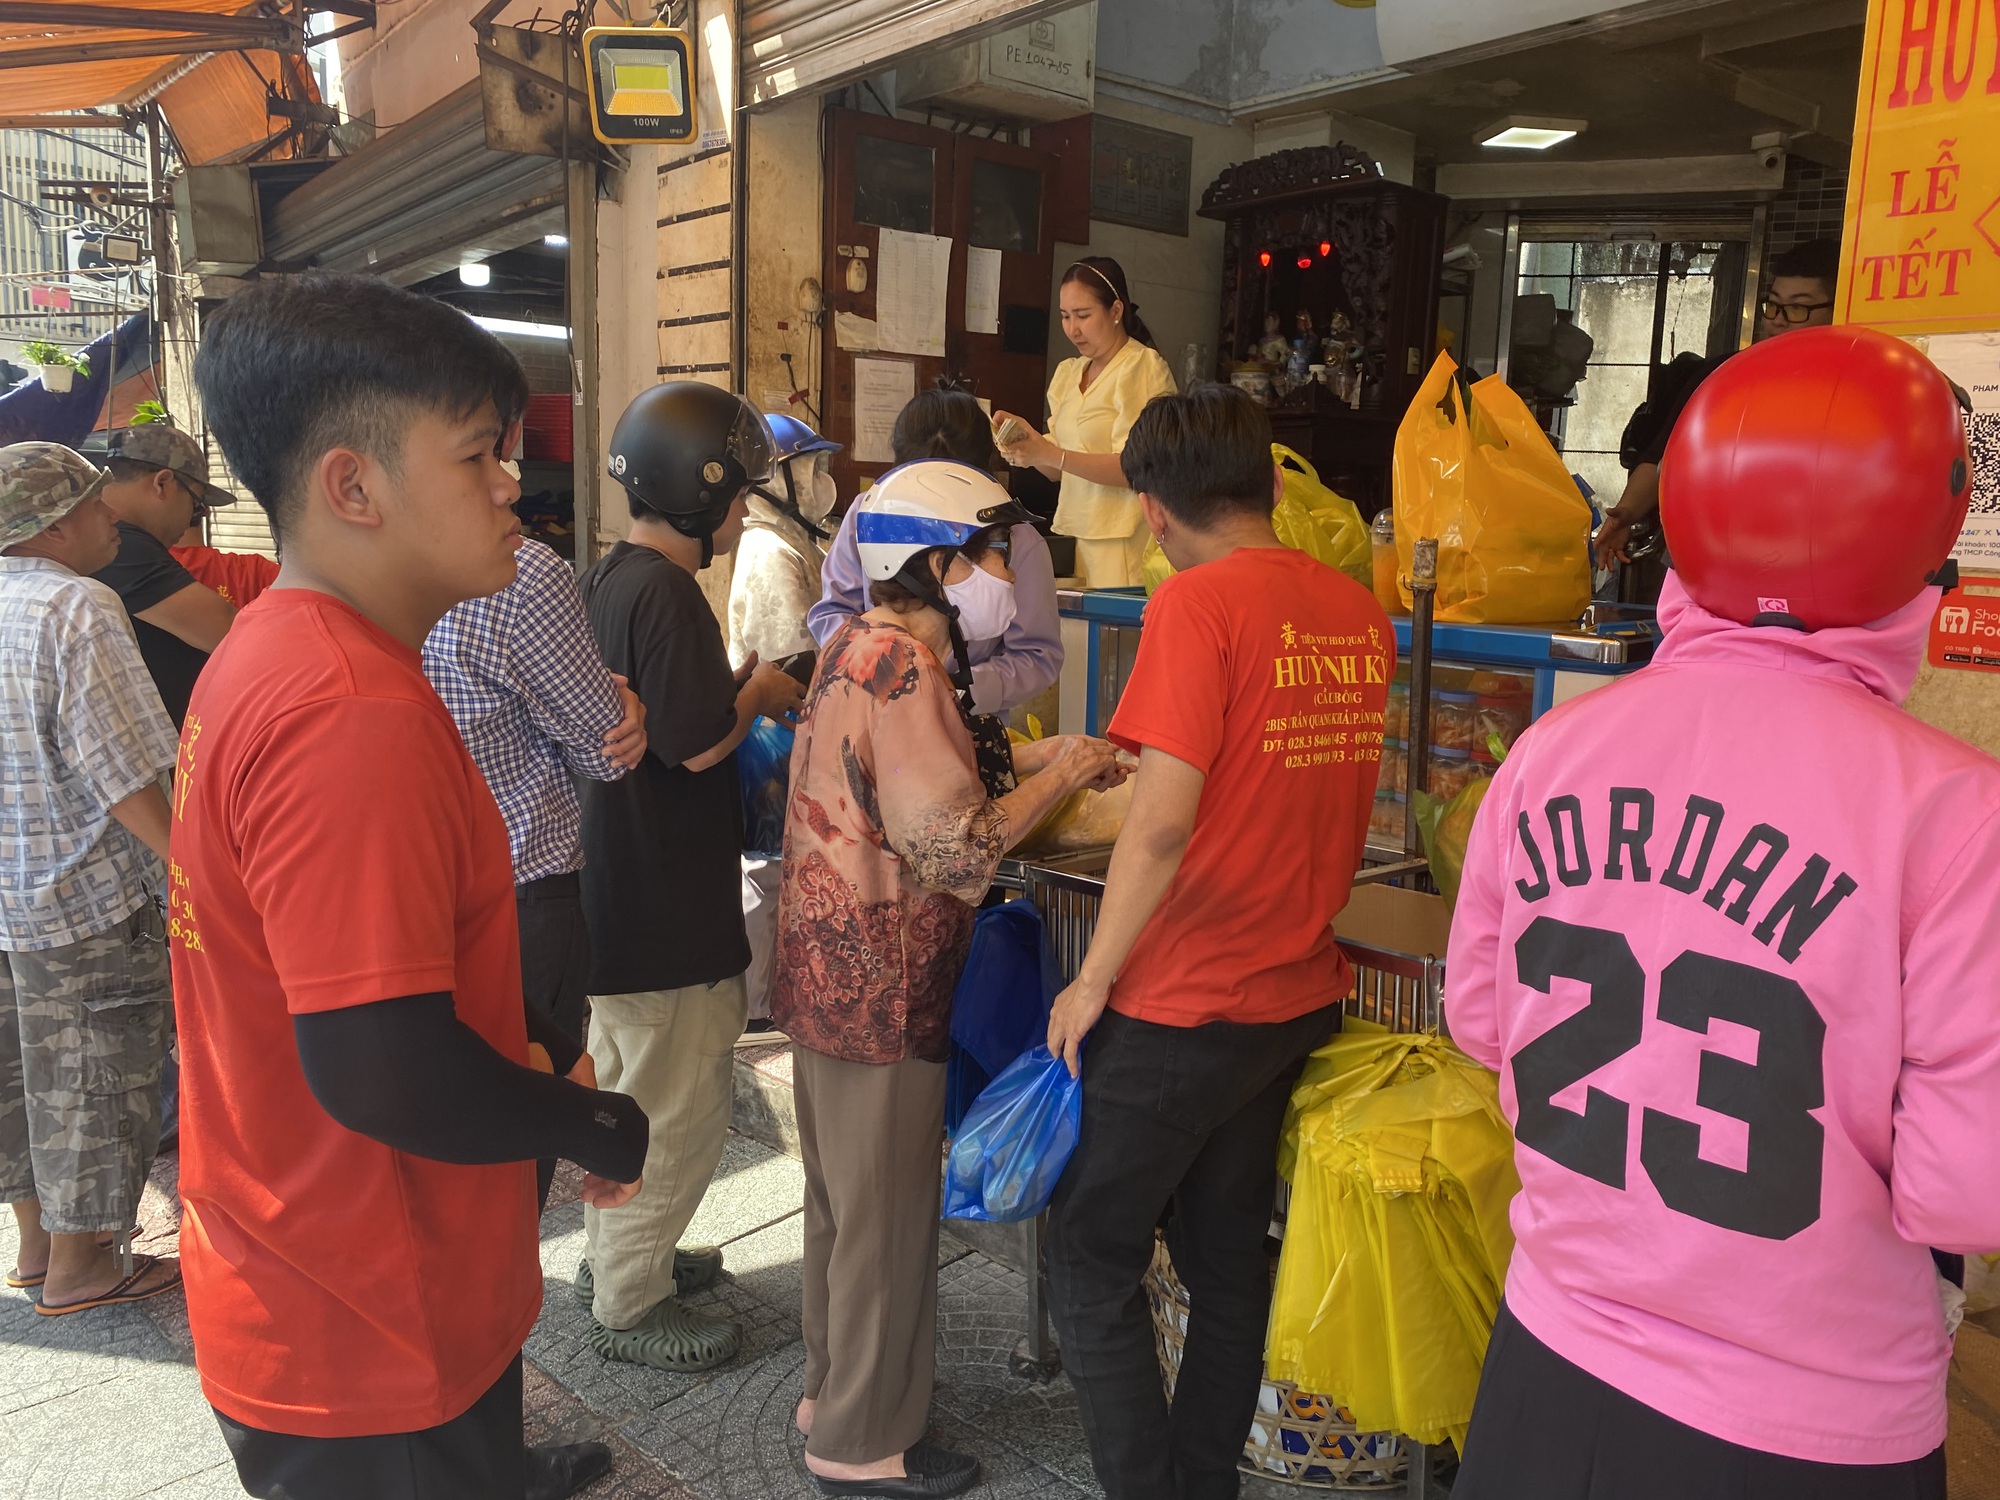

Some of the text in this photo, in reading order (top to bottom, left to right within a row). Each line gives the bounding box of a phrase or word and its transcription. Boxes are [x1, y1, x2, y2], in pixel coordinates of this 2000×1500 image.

[1006, 44, 1022, 63] PE
[633, 118, 660, 127] 100W
[1886, 137, 1960, 218] LỄ
[1861, 227, 1971, 302] TẾT
[1972, 384, 1999, 393] PHAM
[1974, 608, 2000, 624] Sho
[1345, 635, 1367, 647] QUAY
[1274, 646, 1359, 688] HUỲNH
[1264, 717, 1287, 732] 2BIS
[1514, 786, 1859, 964] JORDAN
[1510, 915, 1828, 1241] 23
